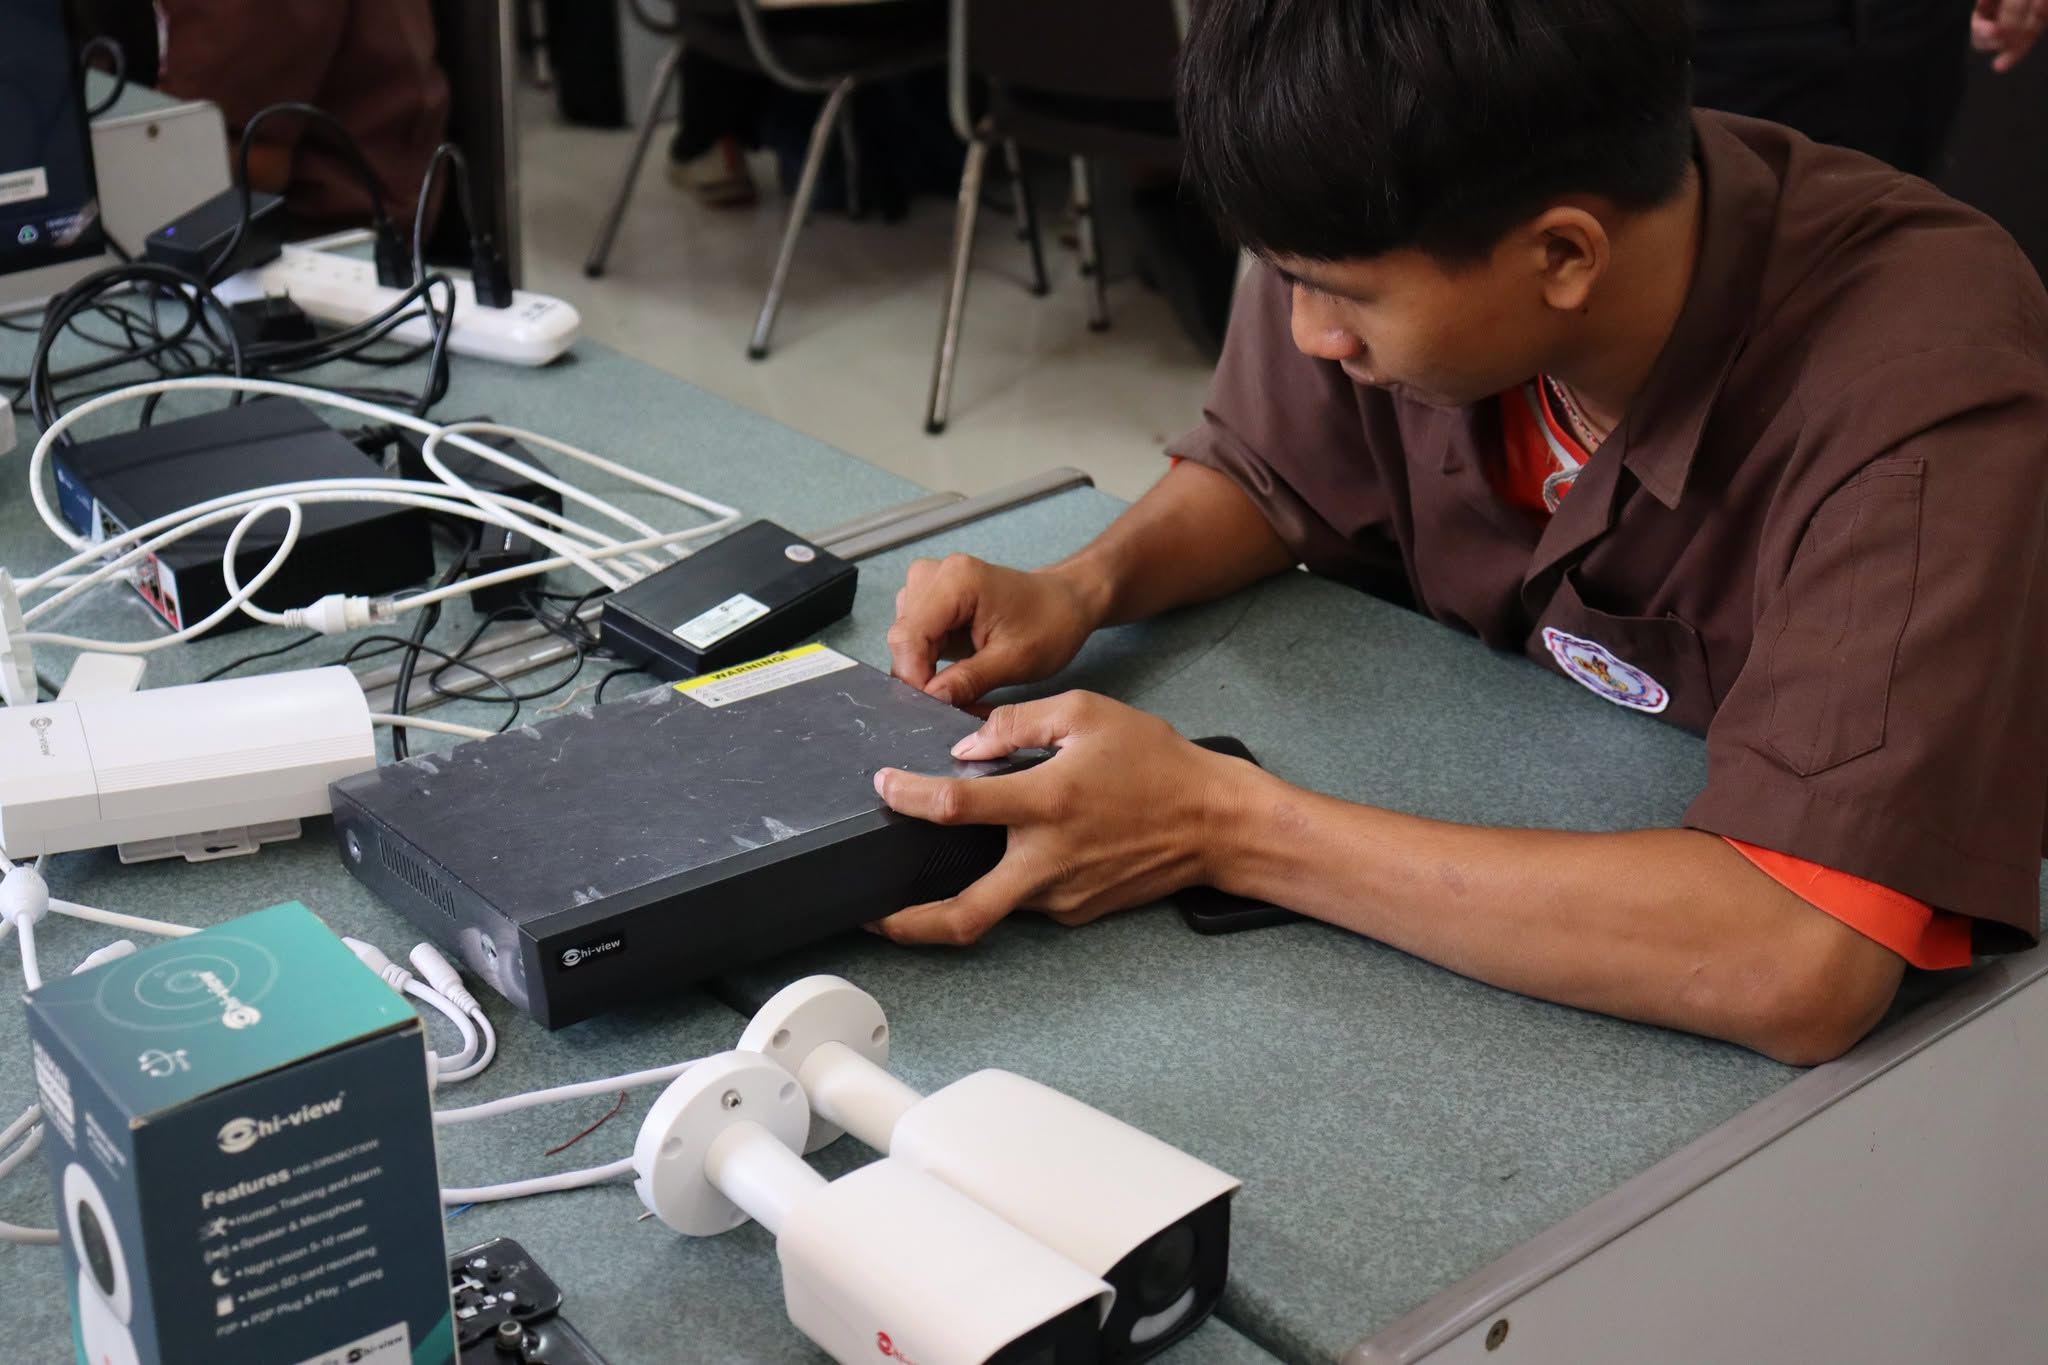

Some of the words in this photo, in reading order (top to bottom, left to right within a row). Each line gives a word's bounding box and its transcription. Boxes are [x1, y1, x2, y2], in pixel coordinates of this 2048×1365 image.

[712, 654, 788, 681] WARNING!
[580, 939, 621, 958] hi-view
[257, 1096, 344, 1137] hi-view
[201, 1168, 291, 1210] Features
[236, 1205, 278, 1225] Human
[279, 1187, 328, 1209] Tracking
[327, 1177, 349, 1193] and
[350, 1166, 382, 1184] Alarm
[239, 1226, 287, 1248] Speaker
[288, 1220, 298, 1232] &
[300, 1198, 364, 1228] Microphone
[243, 1259, 275, 1279] Night
[276, 1247, 307, 1265] vision
[336, 1224, 369, 1242] meter
[246, 1282, 278, 1300] Micro
[280, 1275, 299, 1289] SD
[300, 1264, 325, 1282] card
[326, 1246, 378, 1271] recording
[304, 1294, 314, 1305] &
